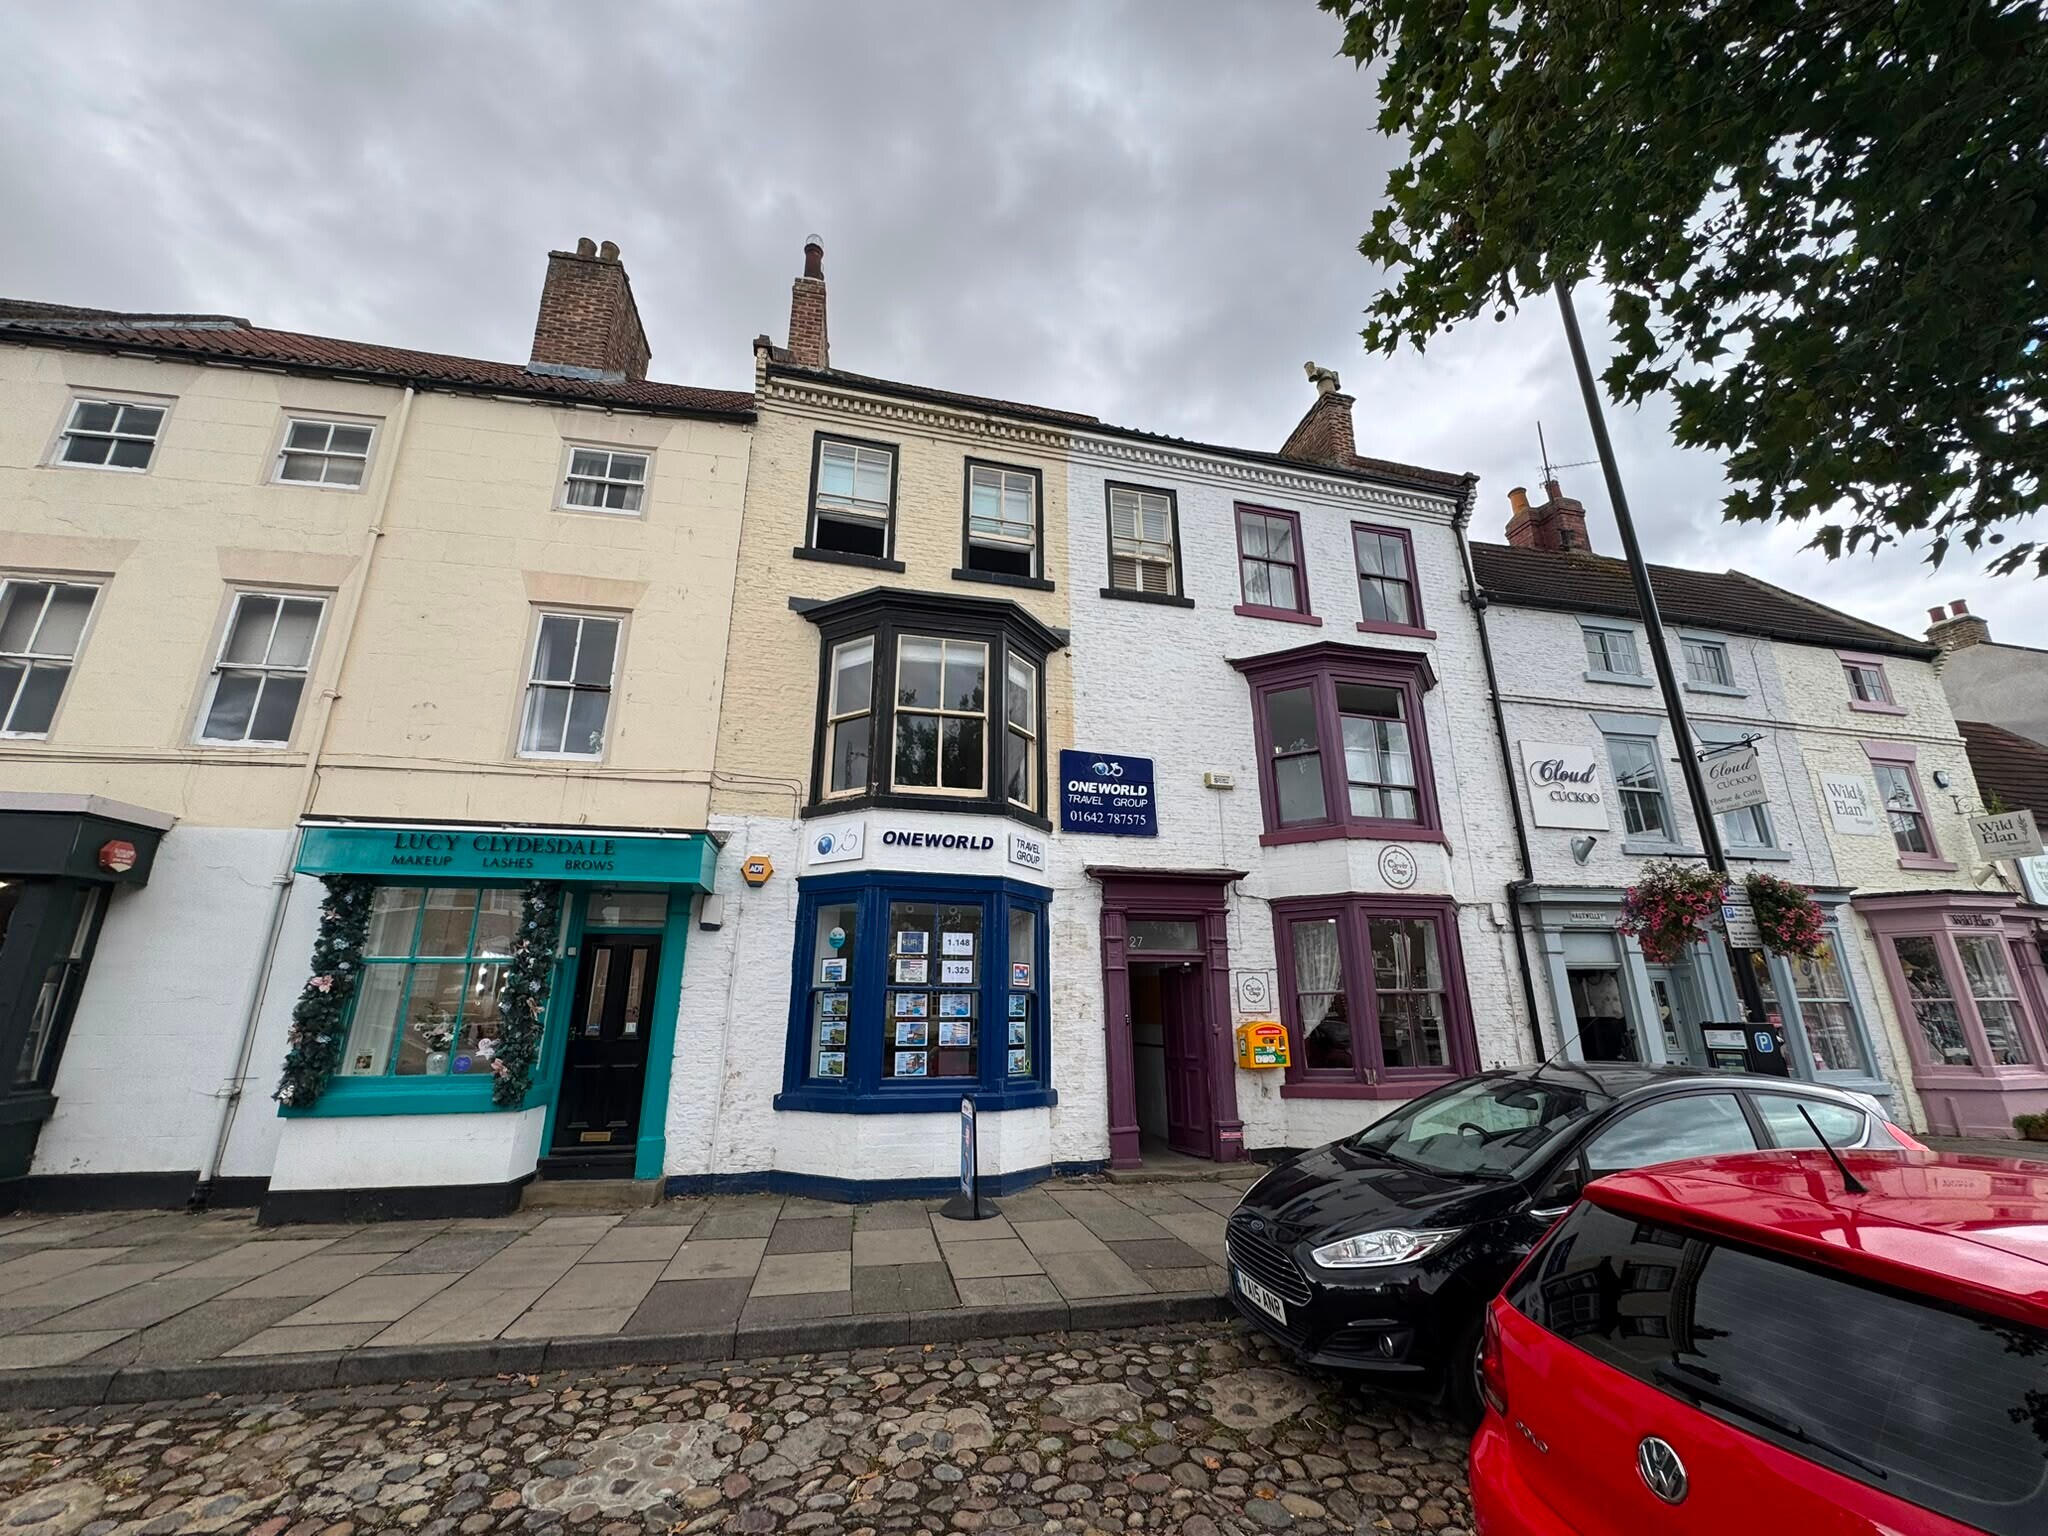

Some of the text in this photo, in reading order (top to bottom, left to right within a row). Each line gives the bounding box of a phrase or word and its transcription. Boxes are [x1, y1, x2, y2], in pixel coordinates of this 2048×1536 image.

[1530, 759, 1596, 787] Cloud
[1709, 754, 1754, 779] Cloud
[1068, 781, 1147, 796] ONEWORLD
[1716, 774, 1757, 790] CUCKOO
[1550, 790, 1600, 803] CUCKOO
[1711, 796, 1733, 806] Home
[1743, 789, 1762, 798] Gifts
[1827, 783, 1858, 799] Wild
[1068, 794, 1148, 808] TRAVEL GROUP
[1070, 810, 1147, 826] 01642 787575
[1977, 819, 2014, 833] Wild
[394, 832, 616, 856] LUCY CLYDESDALE
[882, 830, 994, 851] ONEWORLD
[1016, 838, 1041, 855] TRAVEL
[391, 854, 614, 871] MAKEUP LASHES BROWS
[1016, 850, 1041, 865] GROUP
[749, 864, 764, 874] ADT
[947, 939, 970, 947] 1.148
[1129, 935, 1143, 948] 27
[947, 966, 970, 974] 1.325
